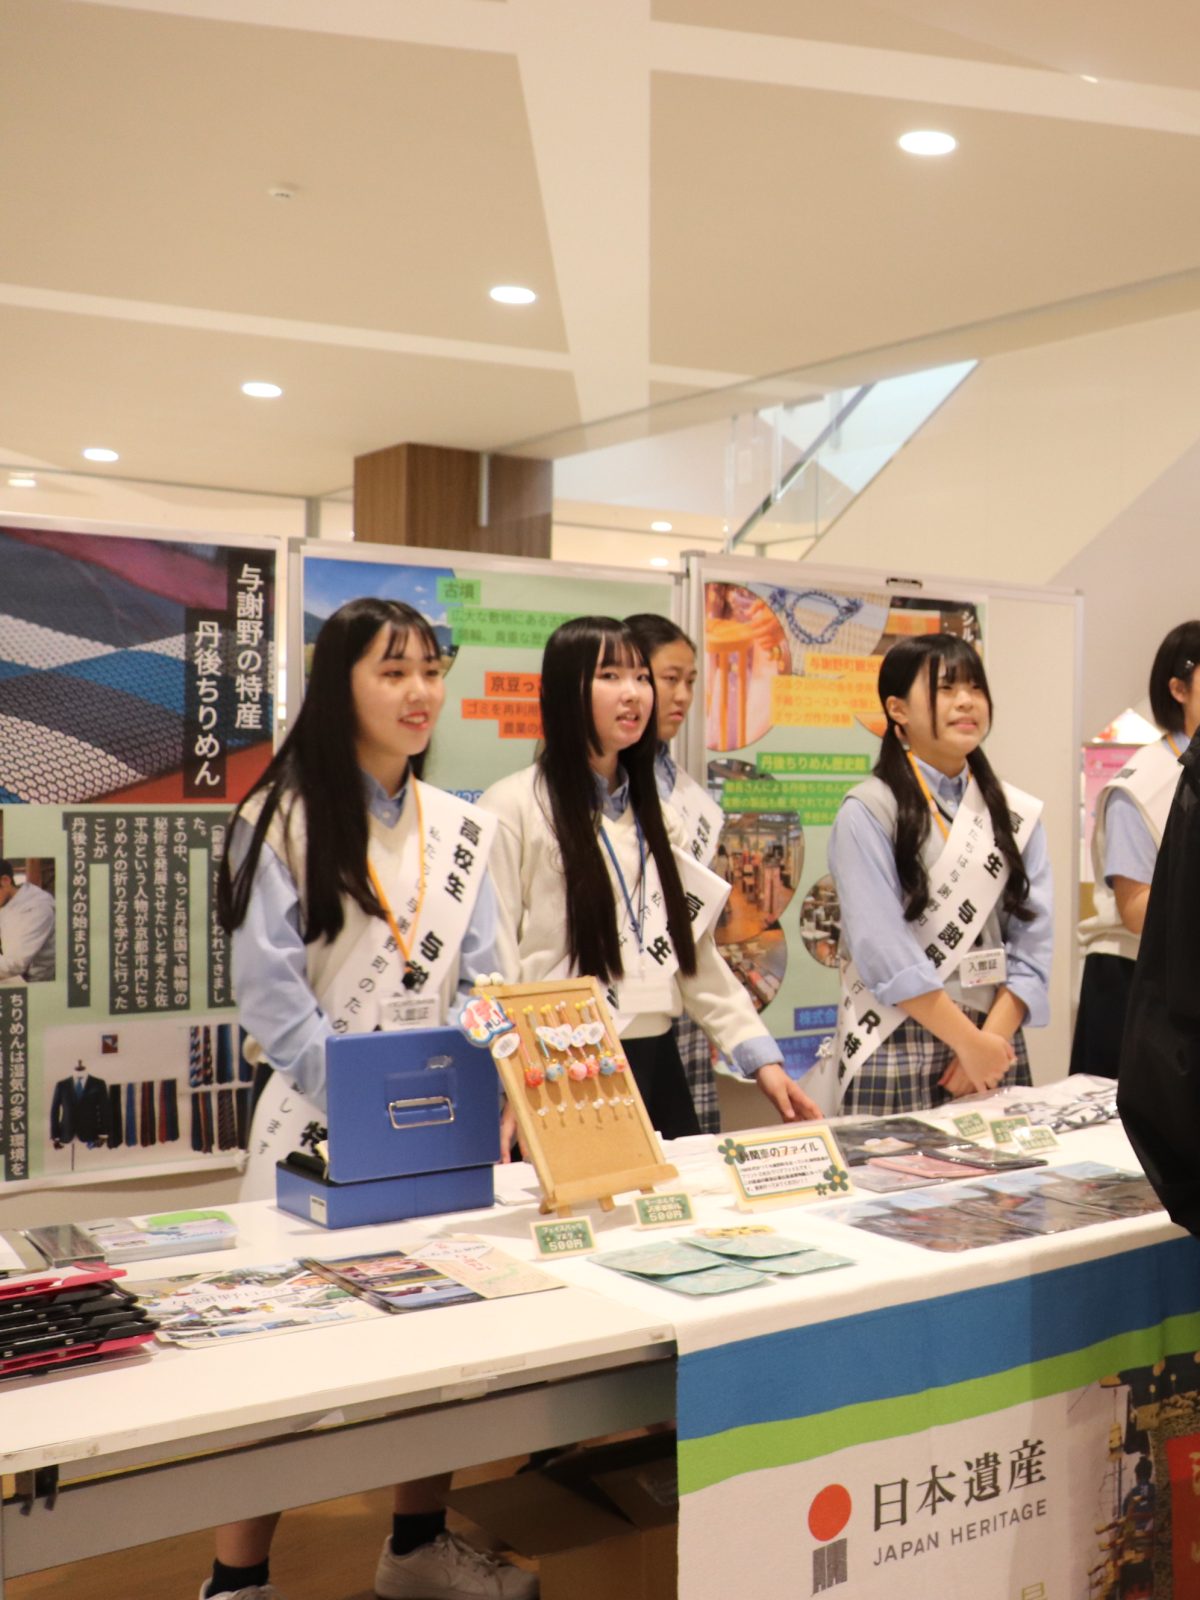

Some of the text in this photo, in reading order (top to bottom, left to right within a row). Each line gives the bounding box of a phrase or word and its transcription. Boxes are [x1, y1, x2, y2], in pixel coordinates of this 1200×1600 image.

[235, 564, 264, 730] 与謝野の特産
[491, 676, 542, 692] 京豆っ
[194, 621, 222, 787] 丹後ちりめん
[94, 818, 108, 859] ことが
[444, 816, 482, 903] 高校生
[72, 817, 88, 990] 丹後ちりめんの始まりです。
[549, 1238, 583, 1251] 500円
[873, 1439, 1047, 1532] 日本遺産
[873, 1499, 1047, 1566] JAPAN HERITAGE
